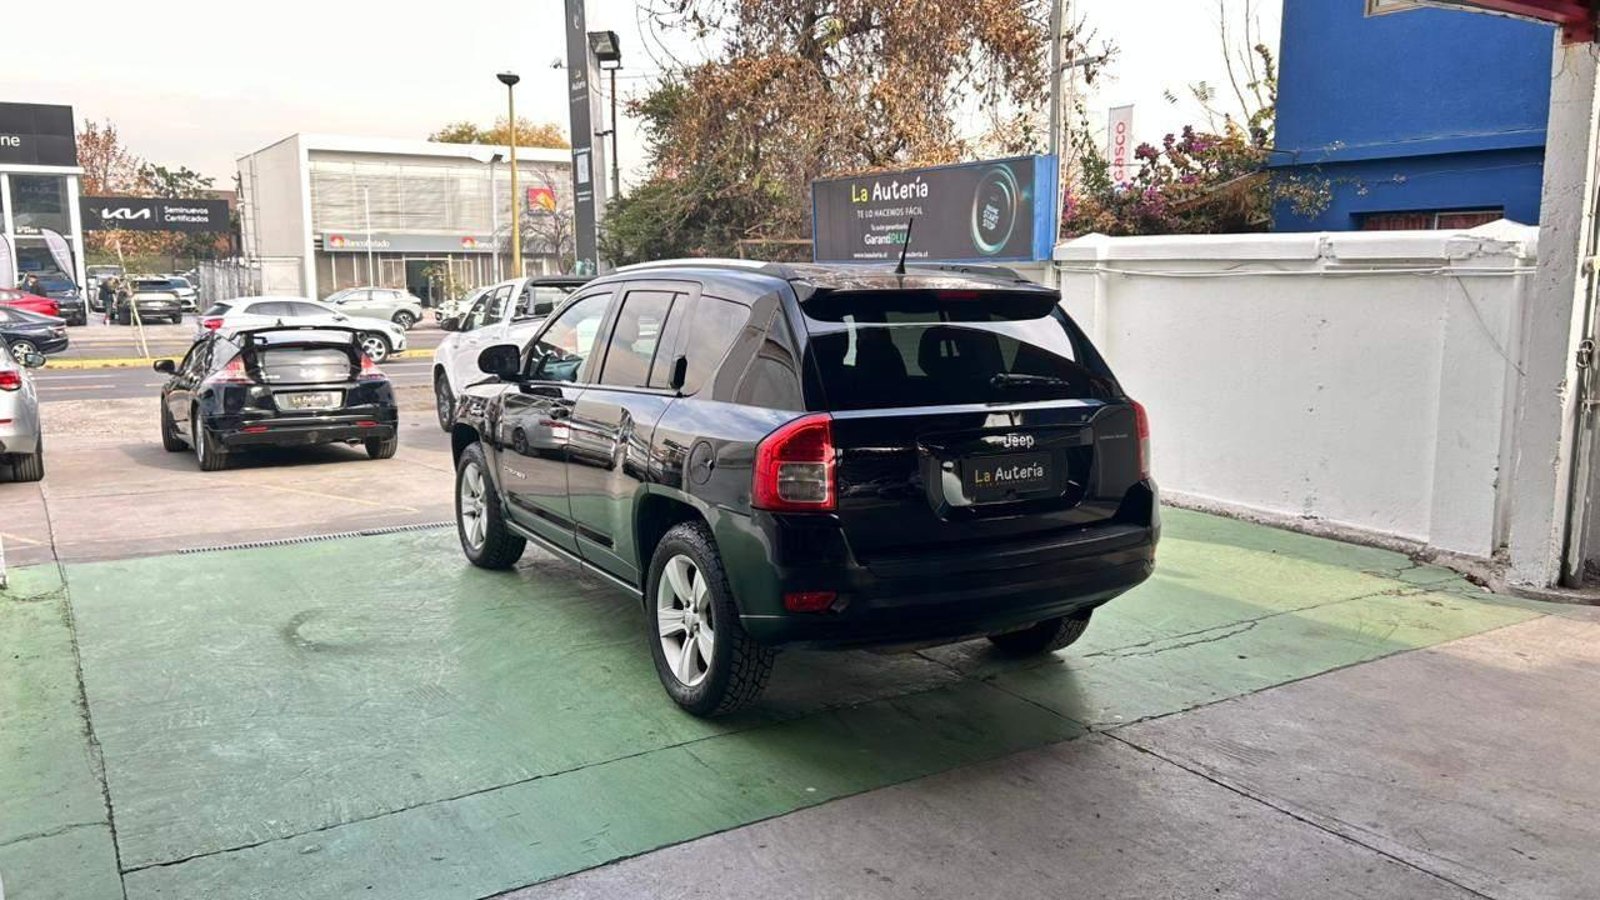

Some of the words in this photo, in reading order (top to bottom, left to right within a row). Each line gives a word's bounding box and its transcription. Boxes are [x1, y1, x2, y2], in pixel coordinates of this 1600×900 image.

[851, 184, 868, 203] La
[872, 175, 929, 201] Autería
[1002, 433, 1035, 449] Jeep
[975, 469, 991, 483] La
[994, 462, 1044, 481] Autería
